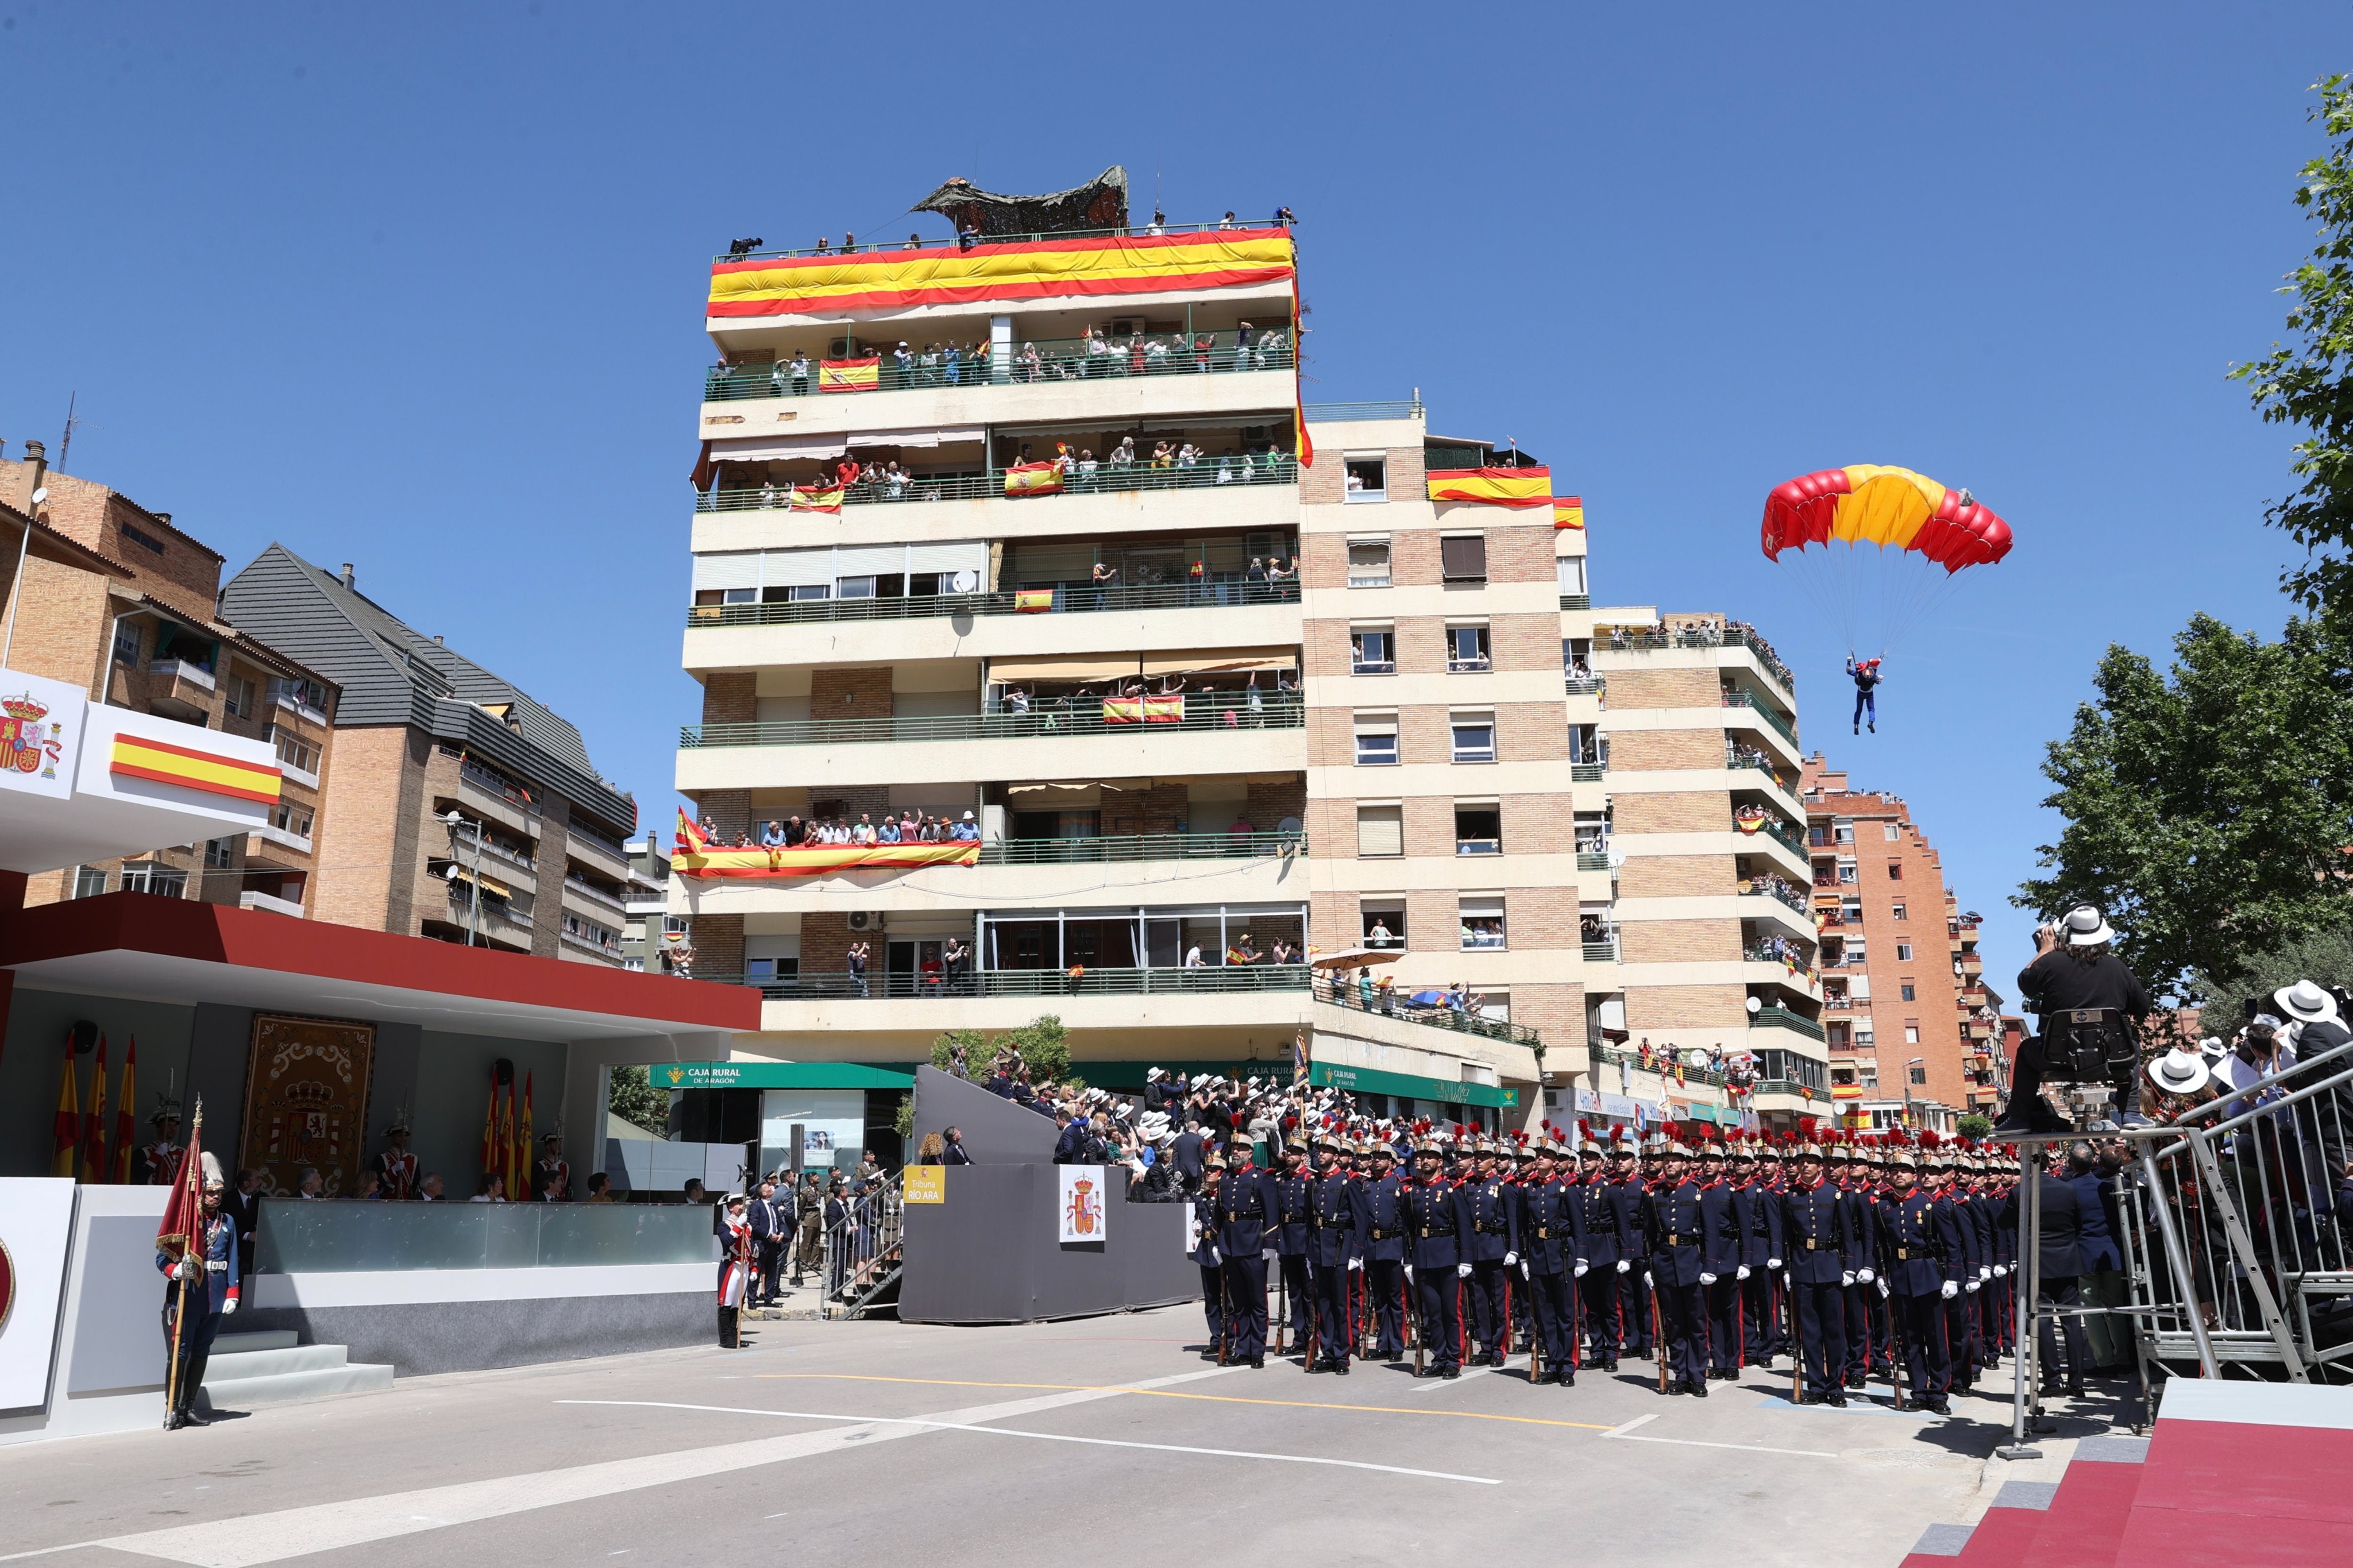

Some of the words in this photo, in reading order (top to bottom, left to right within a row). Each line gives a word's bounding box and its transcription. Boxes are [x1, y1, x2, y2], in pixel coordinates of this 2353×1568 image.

[688, 1068, 710, 1076] CAJA
[712, 1068, 741, 1076] RURAL
[1333, 1069, 1344, 1077] CAJA
[1344, 1071, 1357, 1080] RURAL
[912, 1180, 936, 1188] Tribuna
[908, 1189, 921, 1200] RÍO
[923, 1191, 939, 1200] ARA
